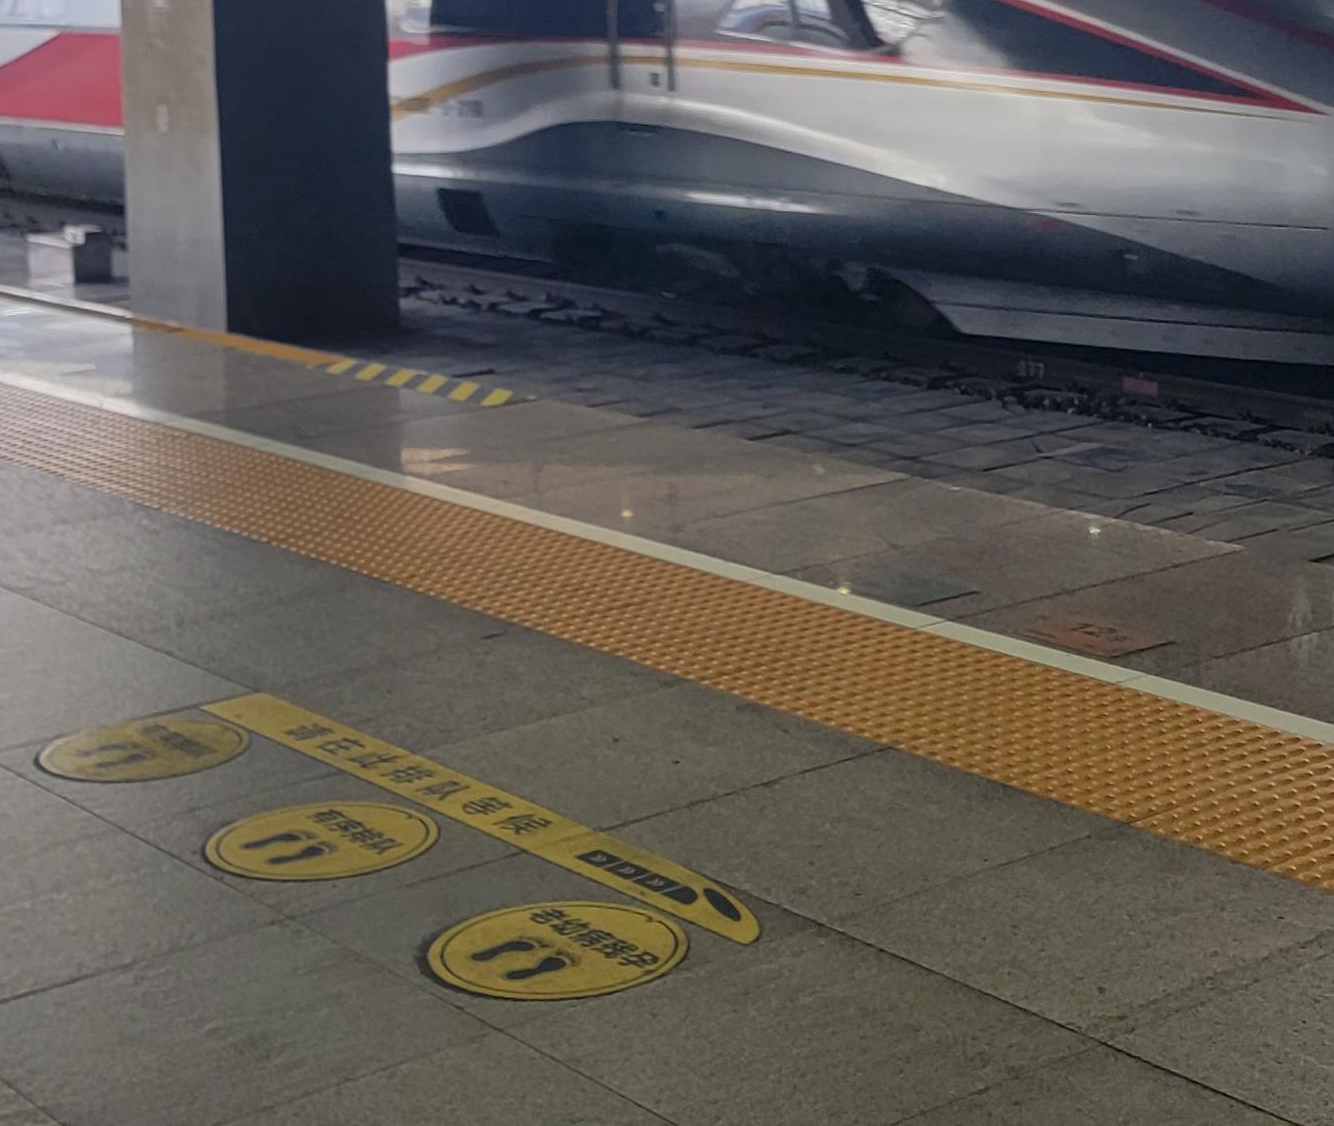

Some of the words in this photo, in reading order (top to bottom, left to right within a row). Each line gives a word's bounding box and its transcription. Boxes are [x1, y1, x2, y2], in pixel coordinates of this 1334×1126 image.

[283, 722, 554, 835] 请在此排队等候
[528, 907, 660, 969] 老幼病残孕
